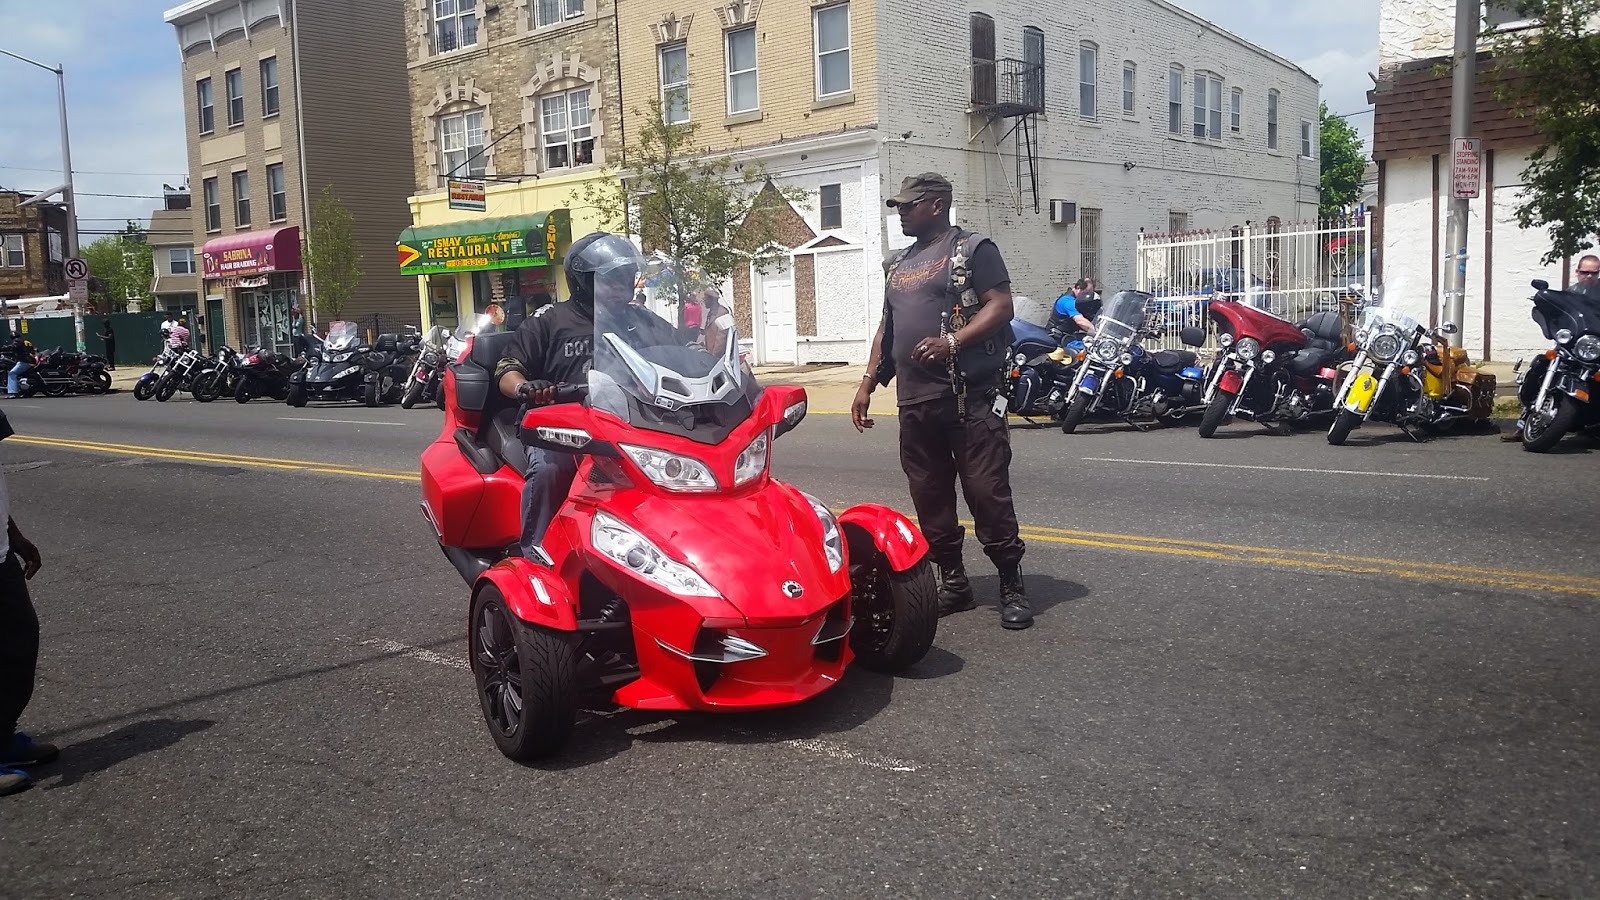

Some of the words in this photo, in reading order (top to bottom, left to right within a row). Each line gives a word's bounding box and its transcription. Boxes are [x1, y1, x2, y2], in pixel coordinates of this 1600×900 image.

[1462, 142, 1472, 150] NO
[433, 237, 461, 248] ISMAY
[547, 215, 556, 259] ISMAY
[224, 248, 252, 261] SABRINA
[428, 241, 509, 258] RESTAURANT
[220, 262, 232, 270] HAIR
[233, 260, 256, 269] BRAIDING
